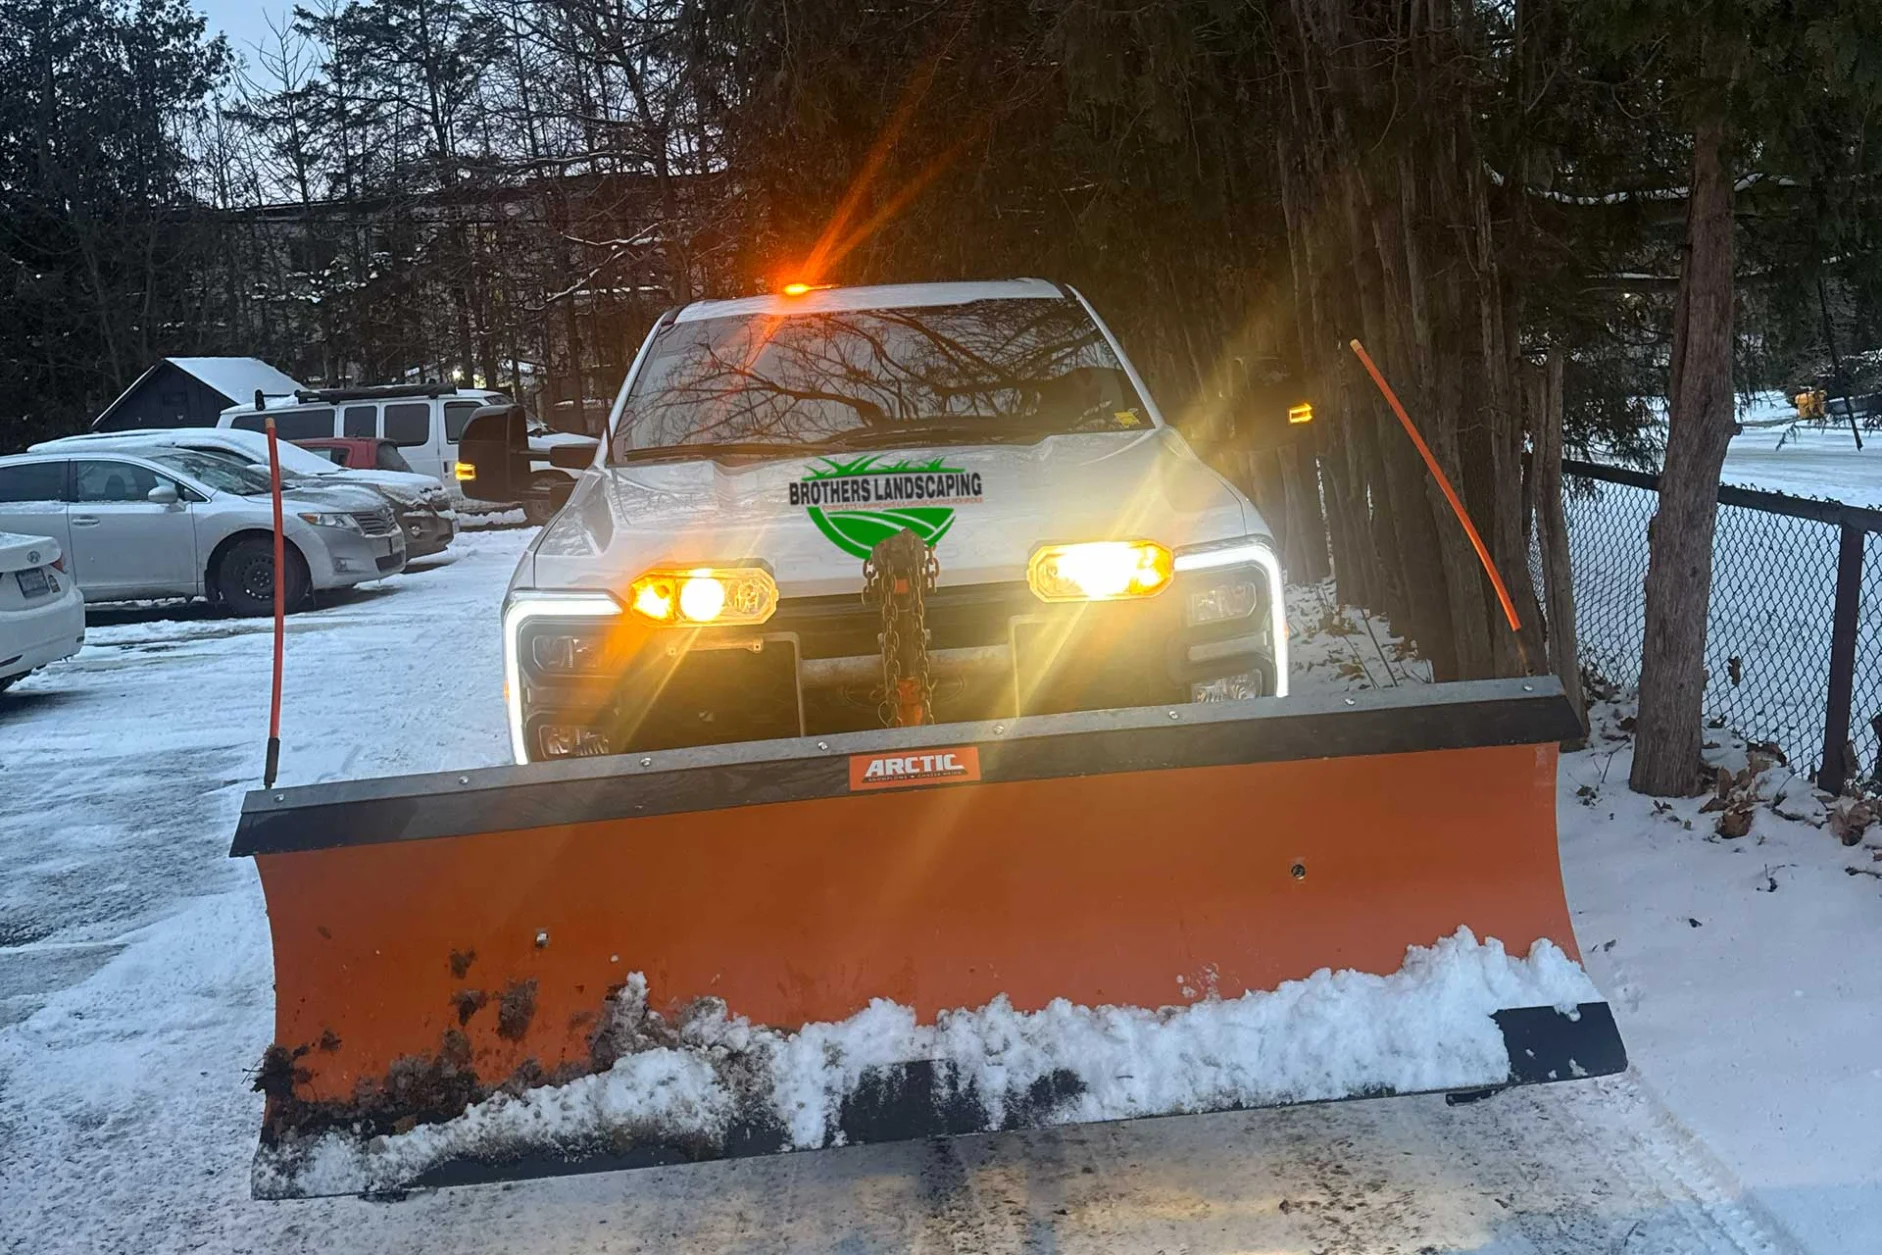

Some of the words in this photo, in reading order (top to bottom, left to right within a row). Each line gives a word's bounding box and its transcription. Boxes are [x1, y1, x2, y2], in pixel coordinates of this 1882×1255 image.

[789, 479, 871, 505] BROTHERS
[874, 472, 983, 501] LANDSCAPING
[864, 753, 965, 777] ARCTIC
